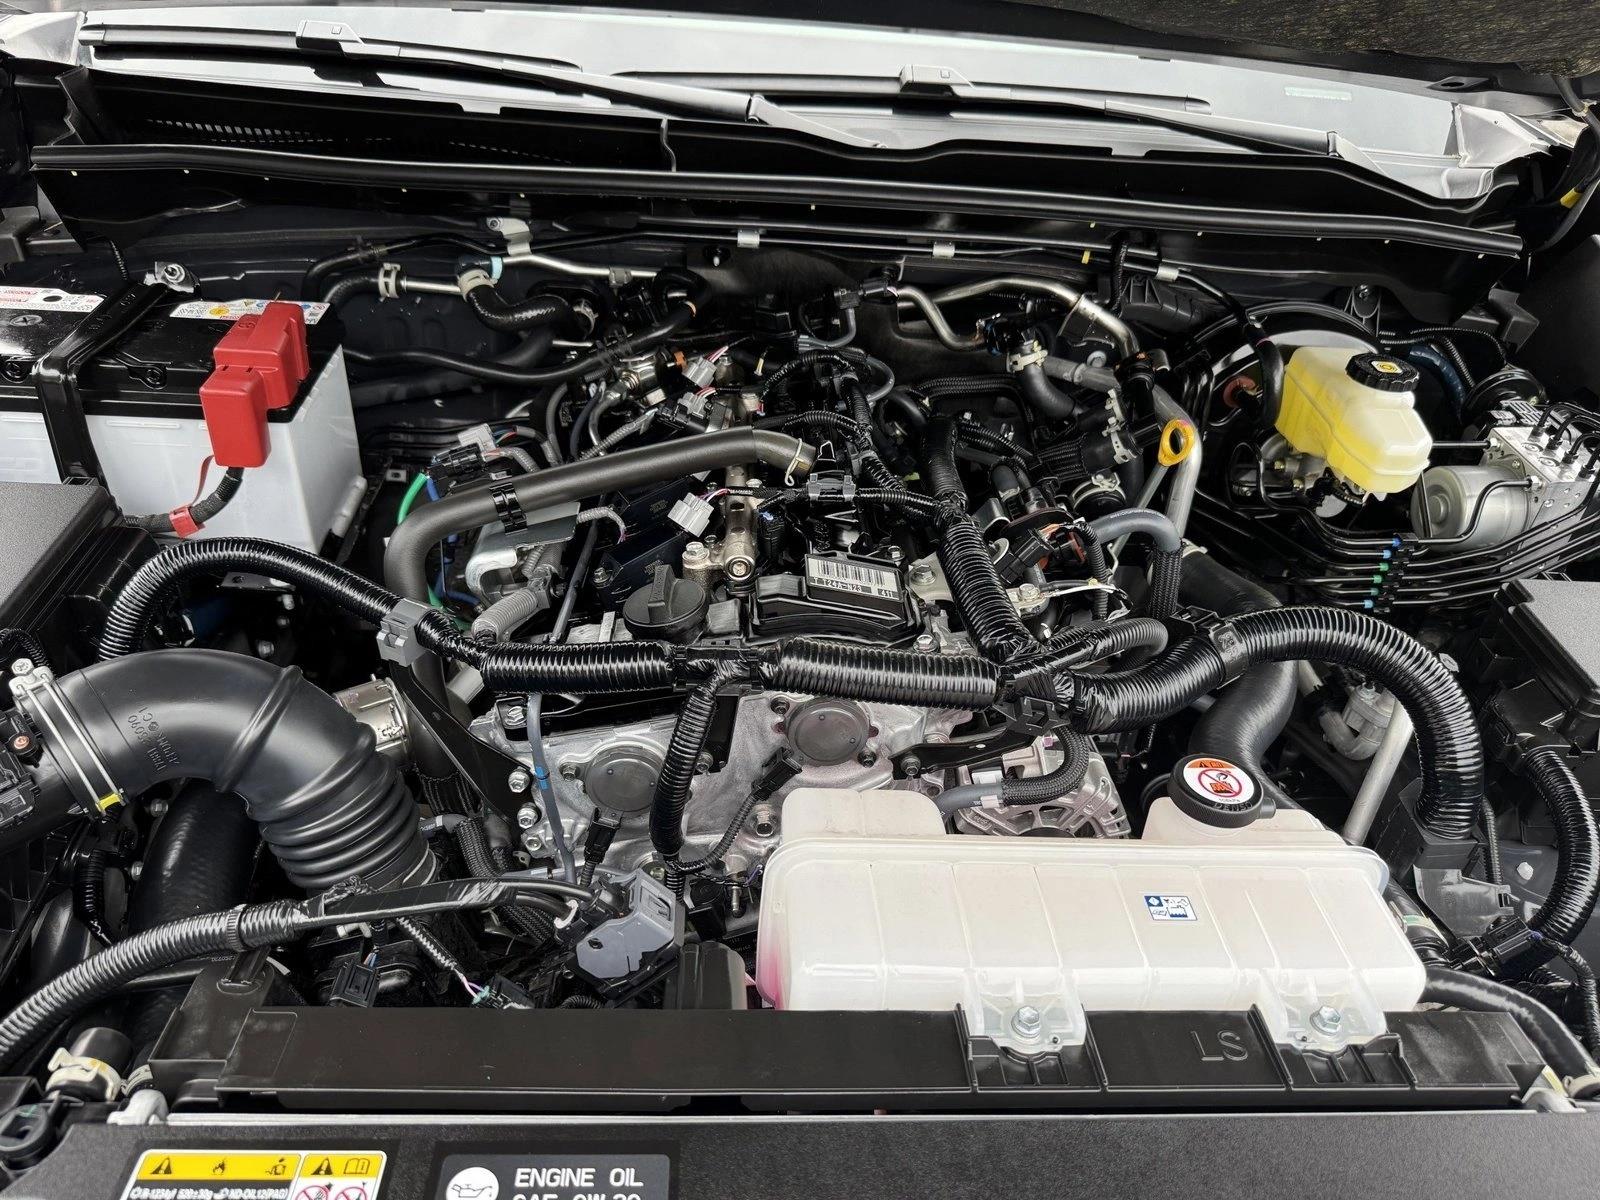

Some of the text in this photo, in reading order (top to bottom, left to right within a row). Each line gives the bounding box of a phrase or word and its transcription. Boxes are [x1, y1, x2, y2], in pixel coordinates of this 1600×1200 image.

[1214, 801, 1253, 812] DENSO
[1191, 1031, 1248, 1061] LS
[514, 1167, 643, 1188] ENGINE OIL
